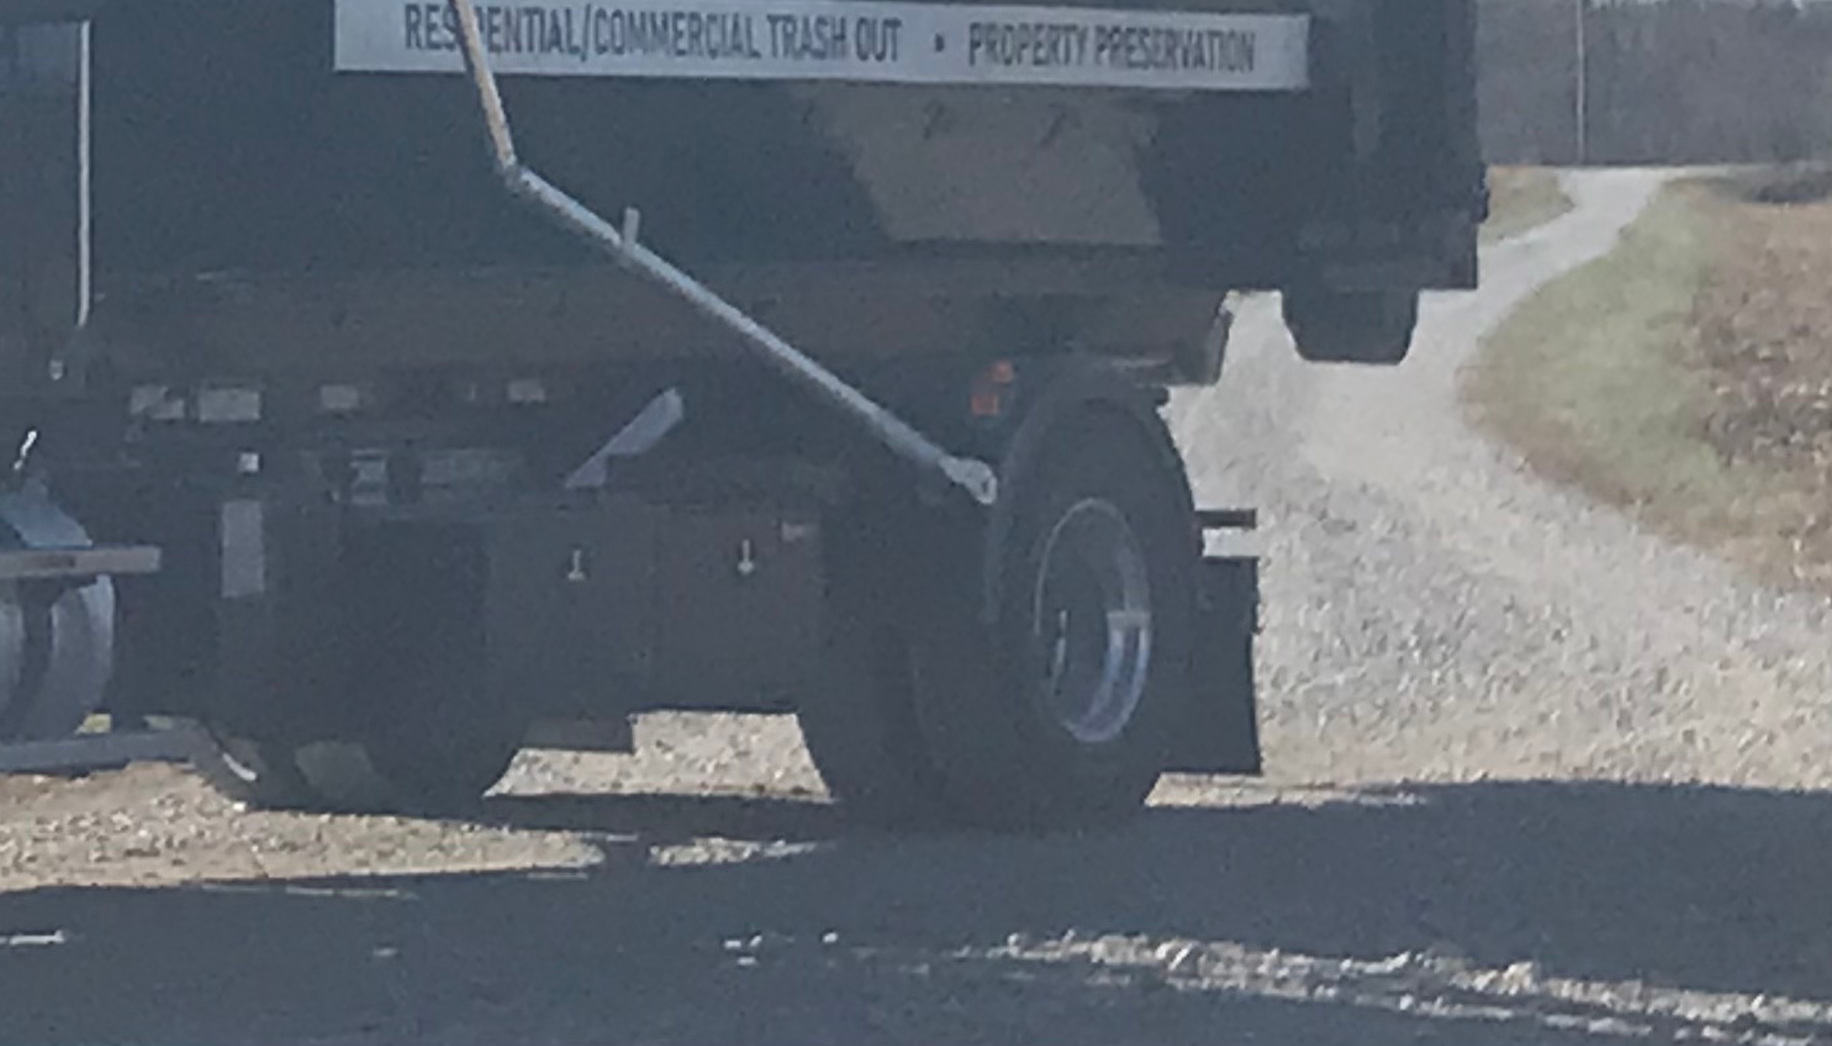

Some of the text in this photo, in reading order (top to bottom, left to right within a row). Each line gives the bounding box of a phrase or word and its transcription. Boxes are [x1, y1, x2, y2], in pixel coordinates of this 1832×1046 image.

[404, 2, 1256, 73] RESENTIAL/COMMERCIAL TRASH OUT PROPERTY PRESERVATION
